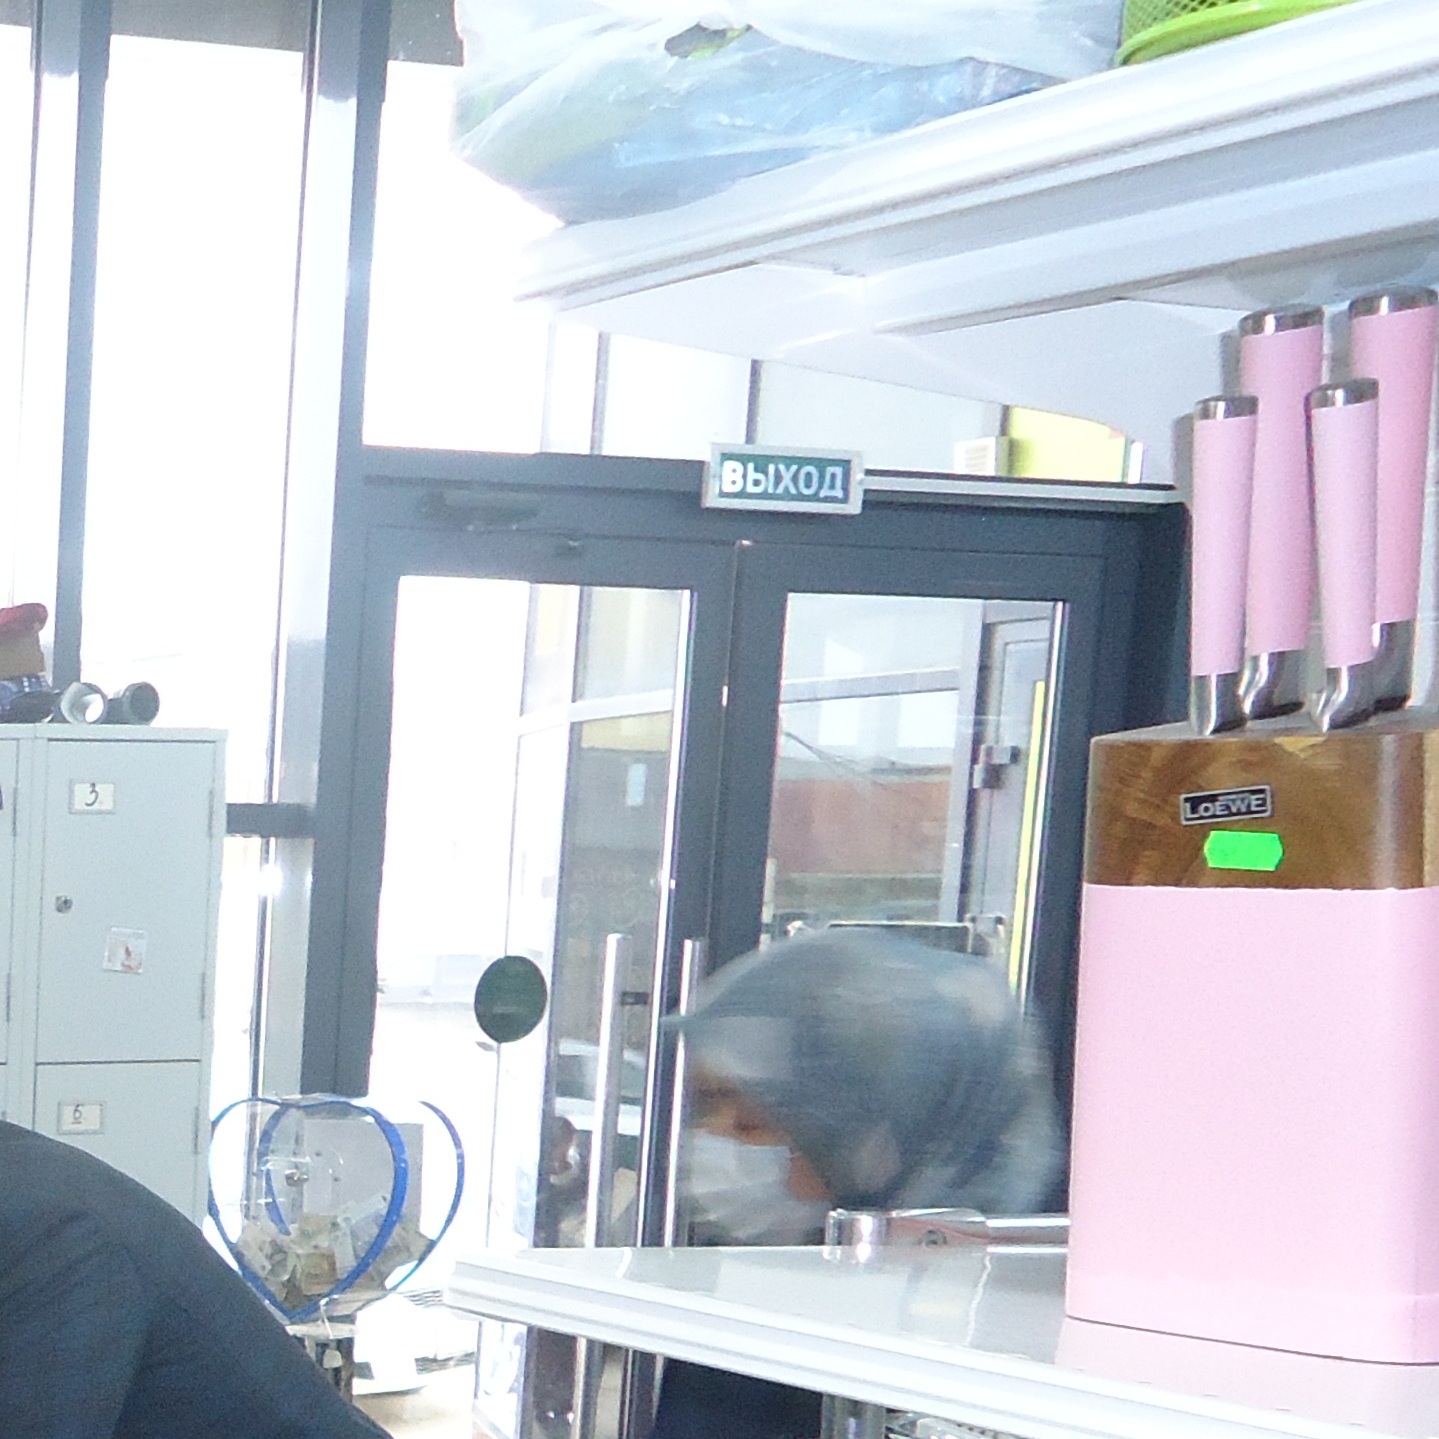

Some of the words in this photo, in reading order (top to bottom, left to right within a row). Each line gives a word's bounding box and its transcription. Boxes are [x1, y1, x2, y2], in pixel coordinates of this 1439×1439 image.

[721, 460, 844, 499] ВЫХОД
[84, 782, 99, 807] 3
[1184, 793, 1267, 818] LOEWE
[73, 1103, 84, 1122] 6
